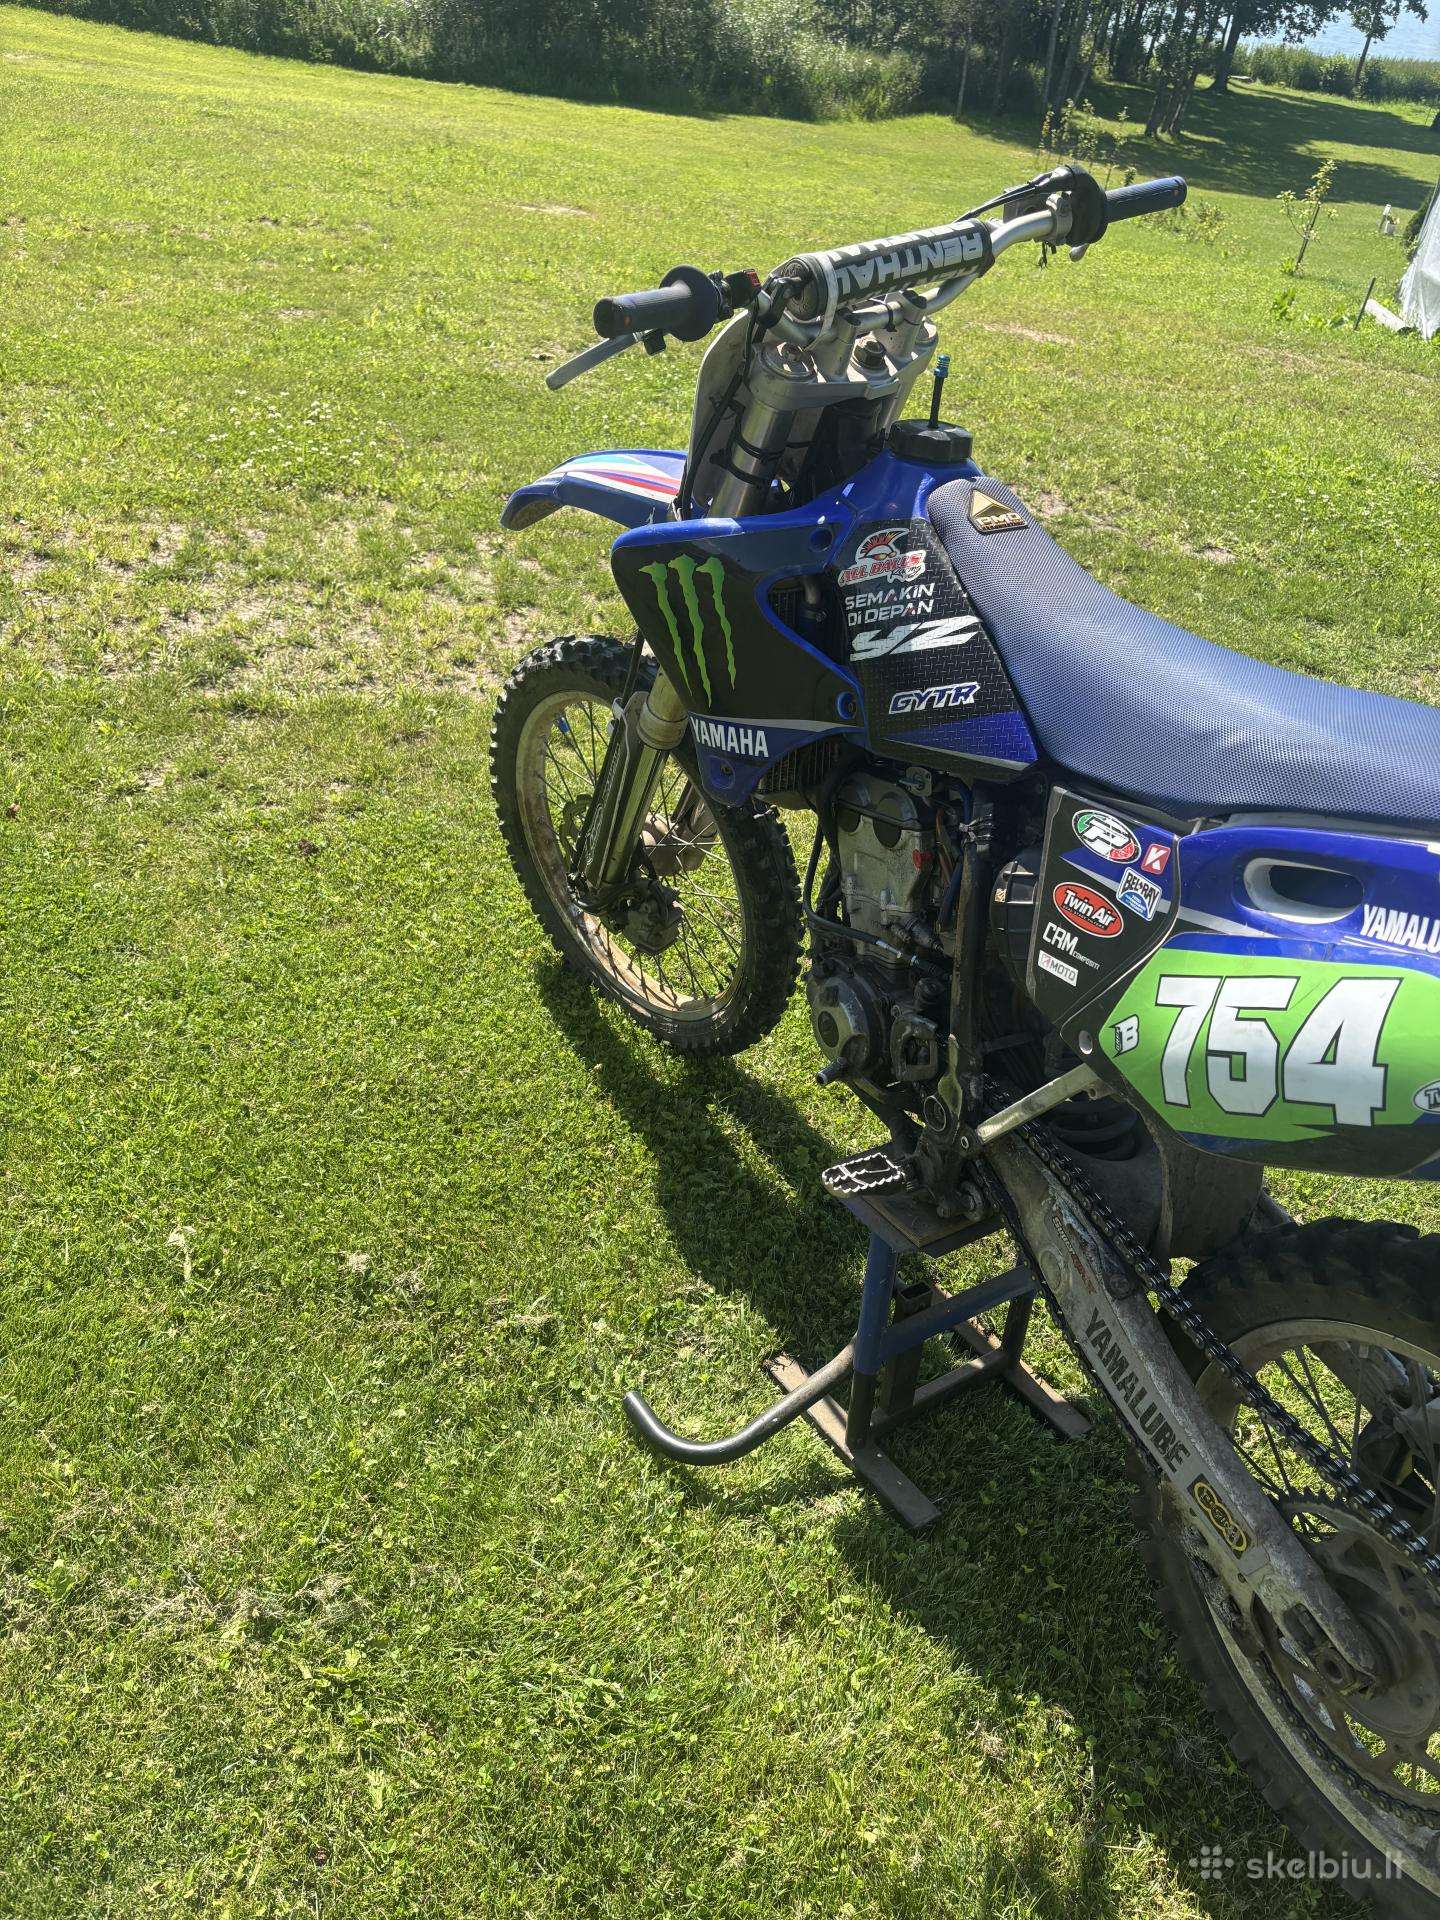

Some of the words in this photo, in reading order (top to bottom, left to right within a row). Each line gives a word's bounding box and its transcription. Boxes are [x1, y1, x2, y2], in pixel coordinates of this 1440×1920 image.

[836, 232, 983, 296] RENTHAL
[864, 599, 934, 624] DEPAN
[849, 615, 980, 662] YZ
[888, 681, 980, 714] GYTR
[690, 716, 769, 758] YAMAHA
[1063, 889, 1094, 917] Twin
[1091, 907, 1116, 926] Air
[1042, 921, 1079, 956] CRM
[1154, 974, 1404, 1127] 754
[1085, 1308, 1190, 1473] YAMALUBE
